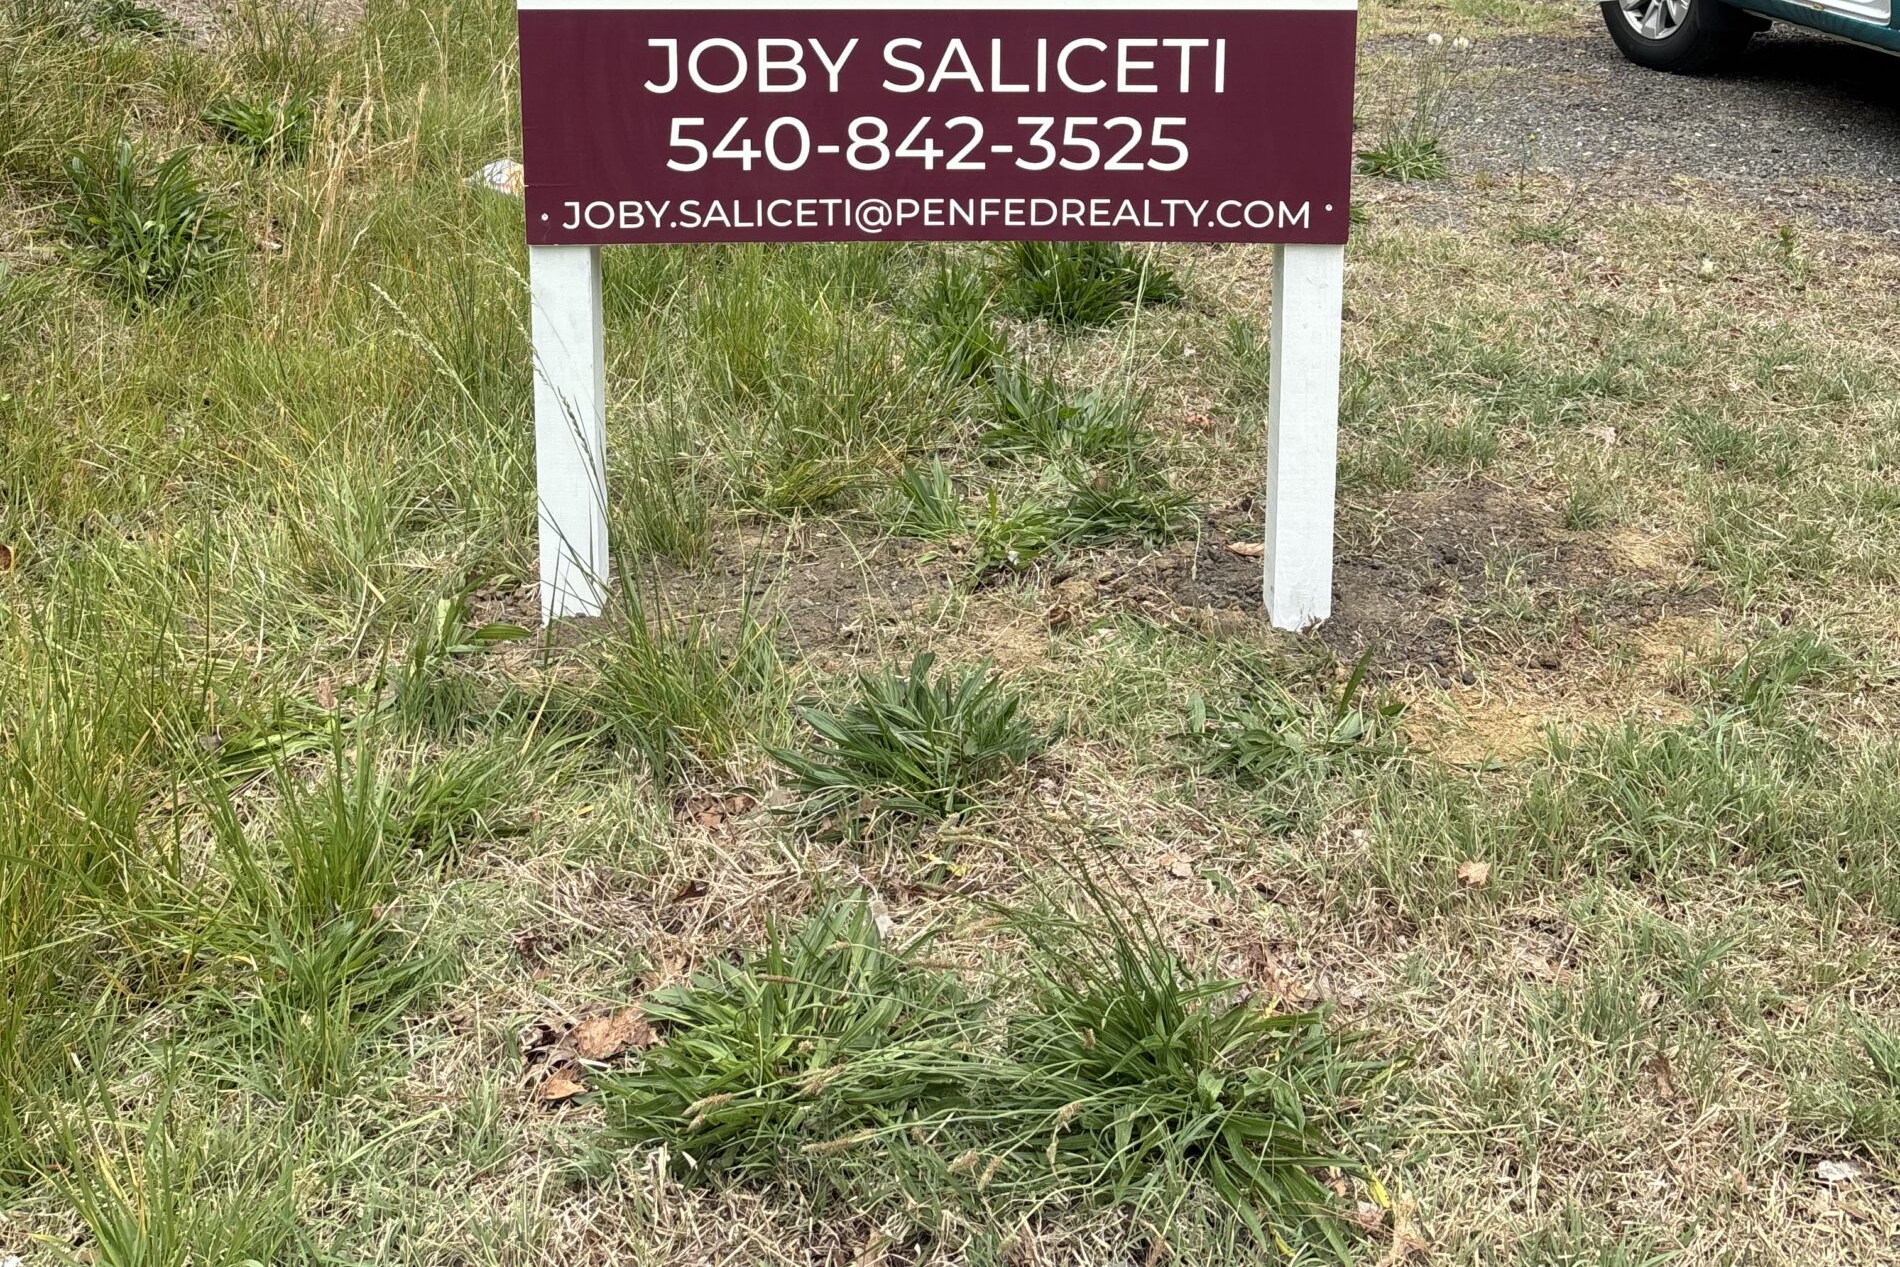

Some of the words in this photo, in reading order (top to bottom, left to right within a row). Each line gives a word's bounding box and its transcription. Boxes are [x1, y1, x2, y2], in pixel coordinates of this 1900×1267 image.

[643, 37, 859, 94] JOBY
[882, 37, 1226, 94] SALICETI
[666, 115, 1189, 172] 540-842-3525
[562, 198, 1310, 234] JOBY.SALICETI@PENFEDREALTY.COM
